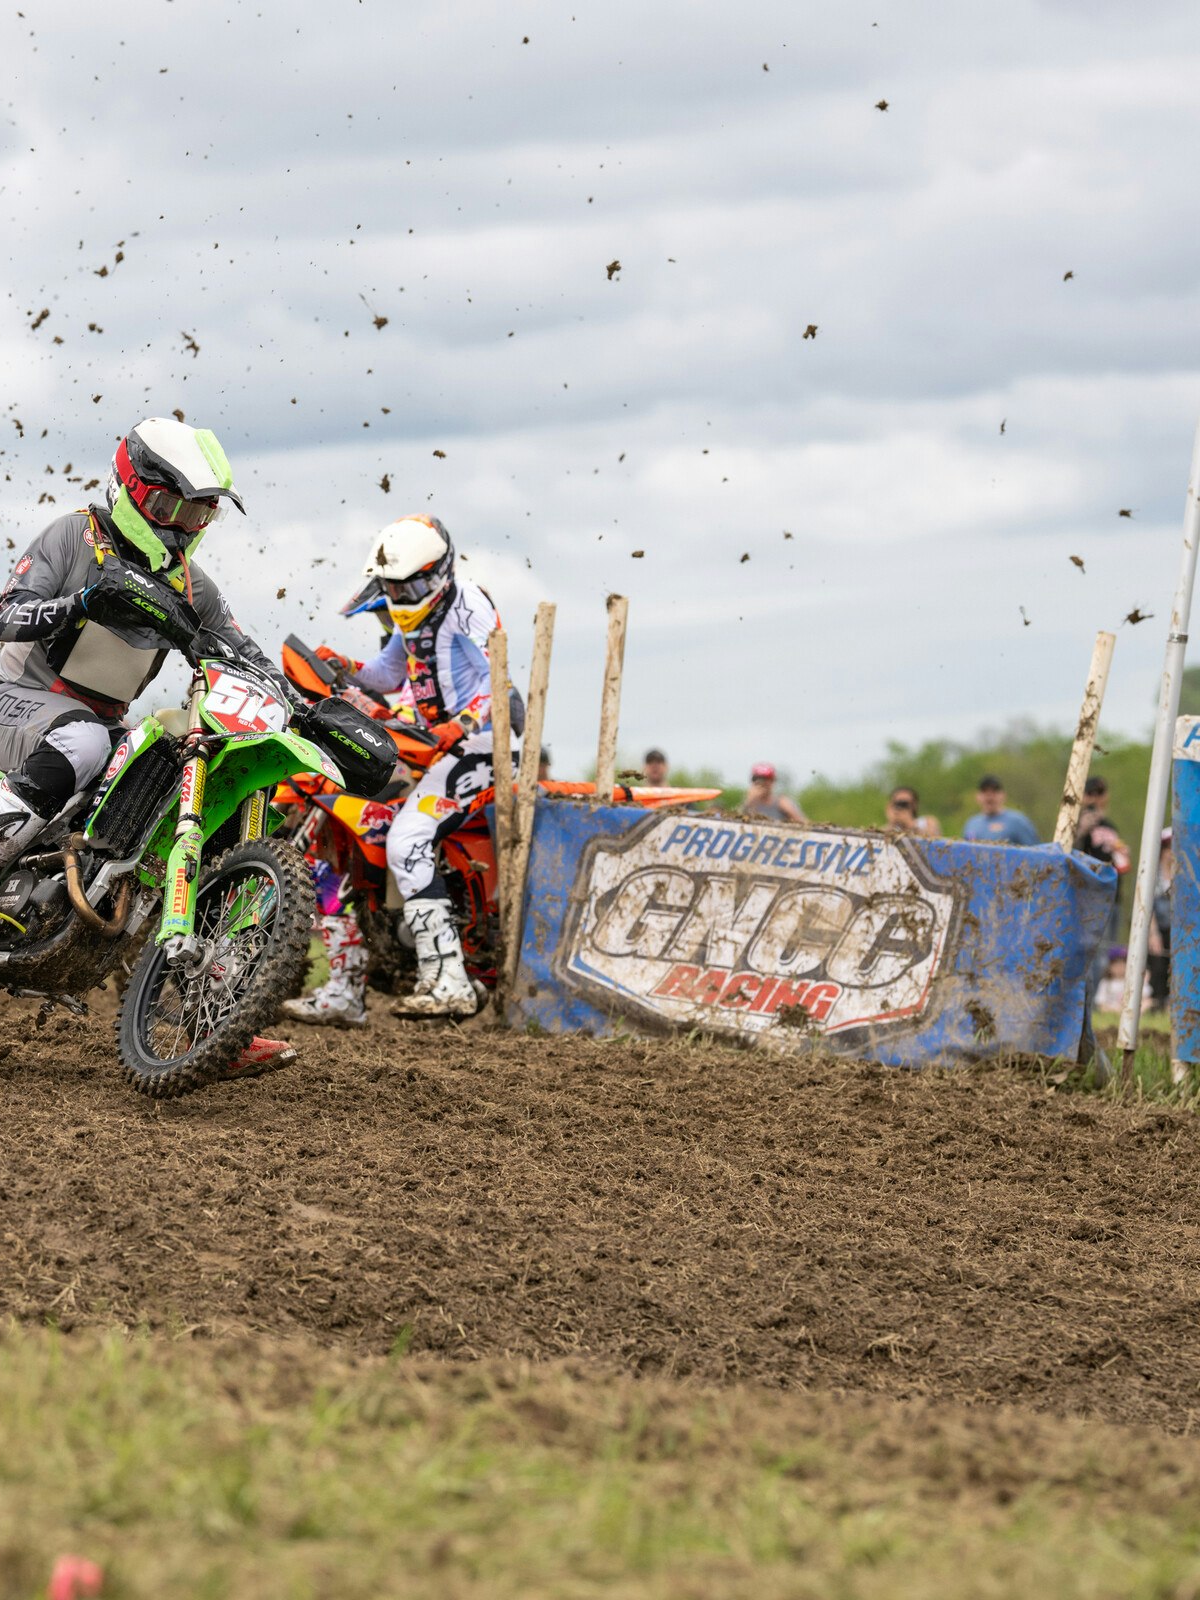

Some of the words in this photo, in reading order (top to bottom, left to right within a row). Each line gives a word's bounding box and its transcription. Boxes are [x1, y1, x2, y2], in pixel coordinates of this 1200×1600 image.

[125, 569, 154, 589] ASV
[203, 672, 287, 732] 514
[355, 728, 383, 748] ASV
[660, 823, 883, 876] PROGRESSIVE
[593, 866, 938, 989] GNCC
[652, 963, 843, 1022] RACING
